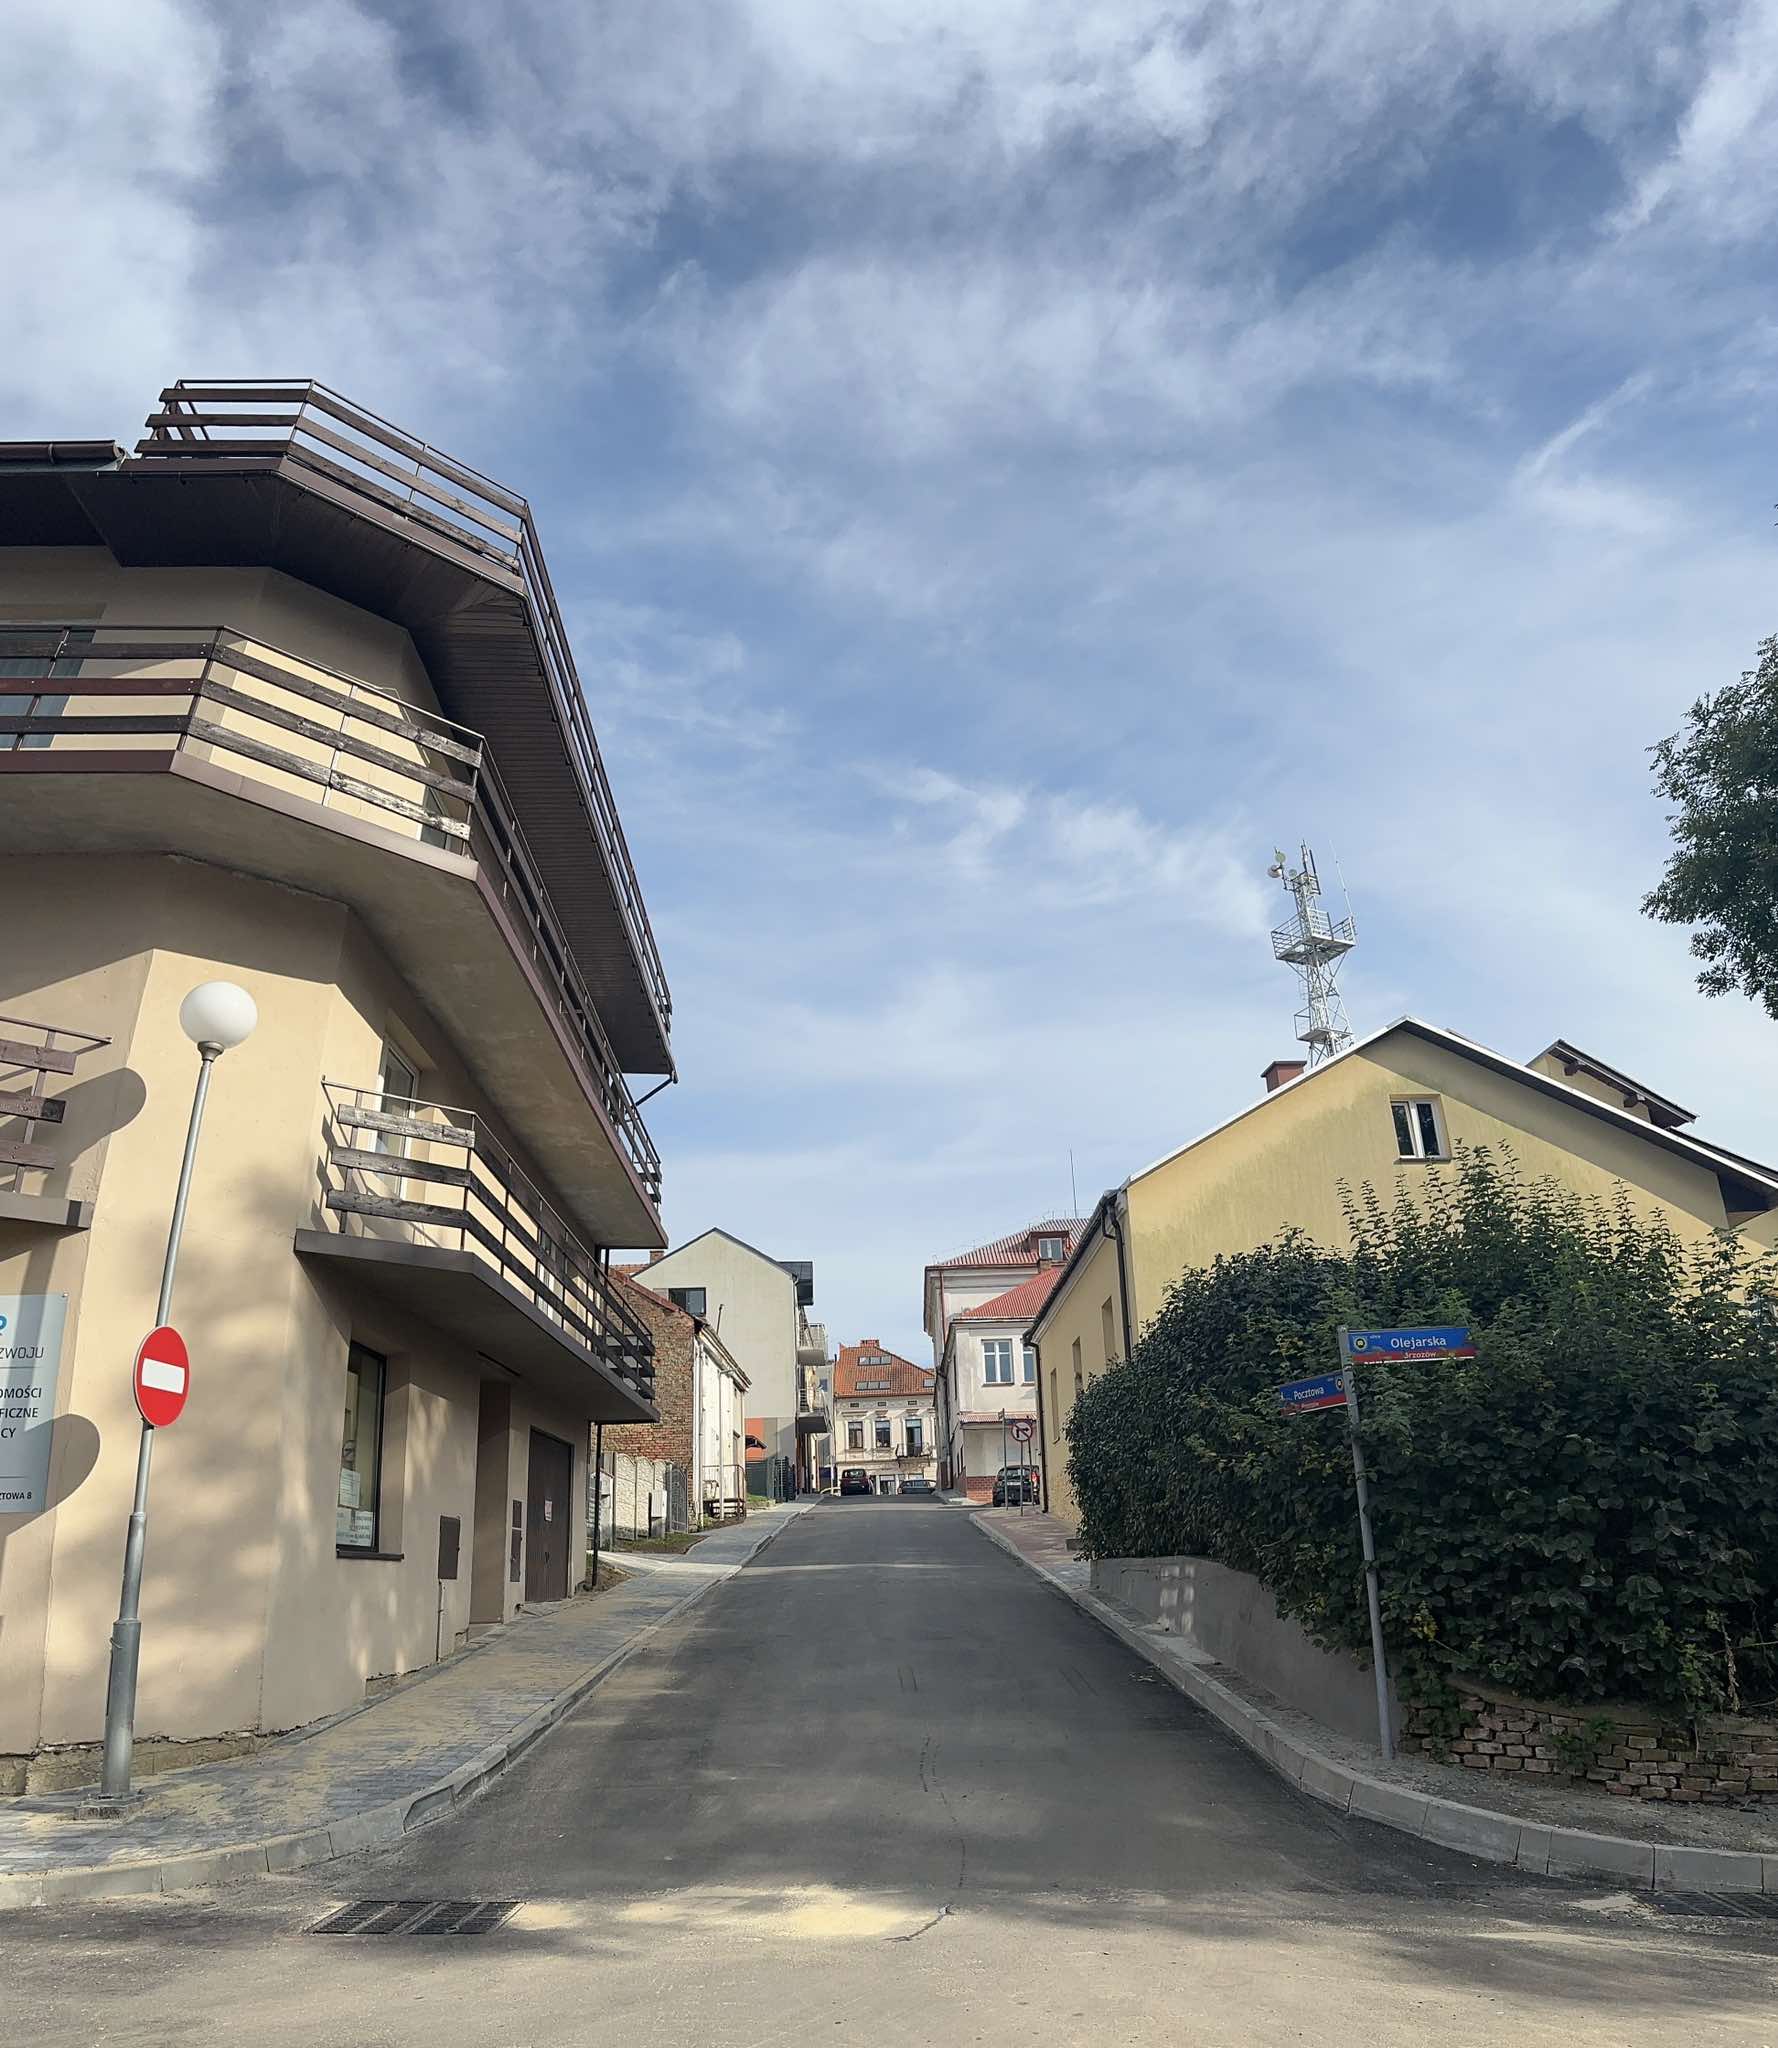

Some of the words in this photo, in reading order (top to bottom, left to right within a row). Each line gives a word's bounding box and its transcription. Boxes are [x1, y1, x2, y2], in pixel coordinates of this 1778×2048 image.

[1391, 1336, 1446, 1349] Olejarska
[1293, 1386, 1325, 1400] Pocztowa
[0, 1492, 25, 1500] TOWA
[26, 1491, 32, 1500] 8
